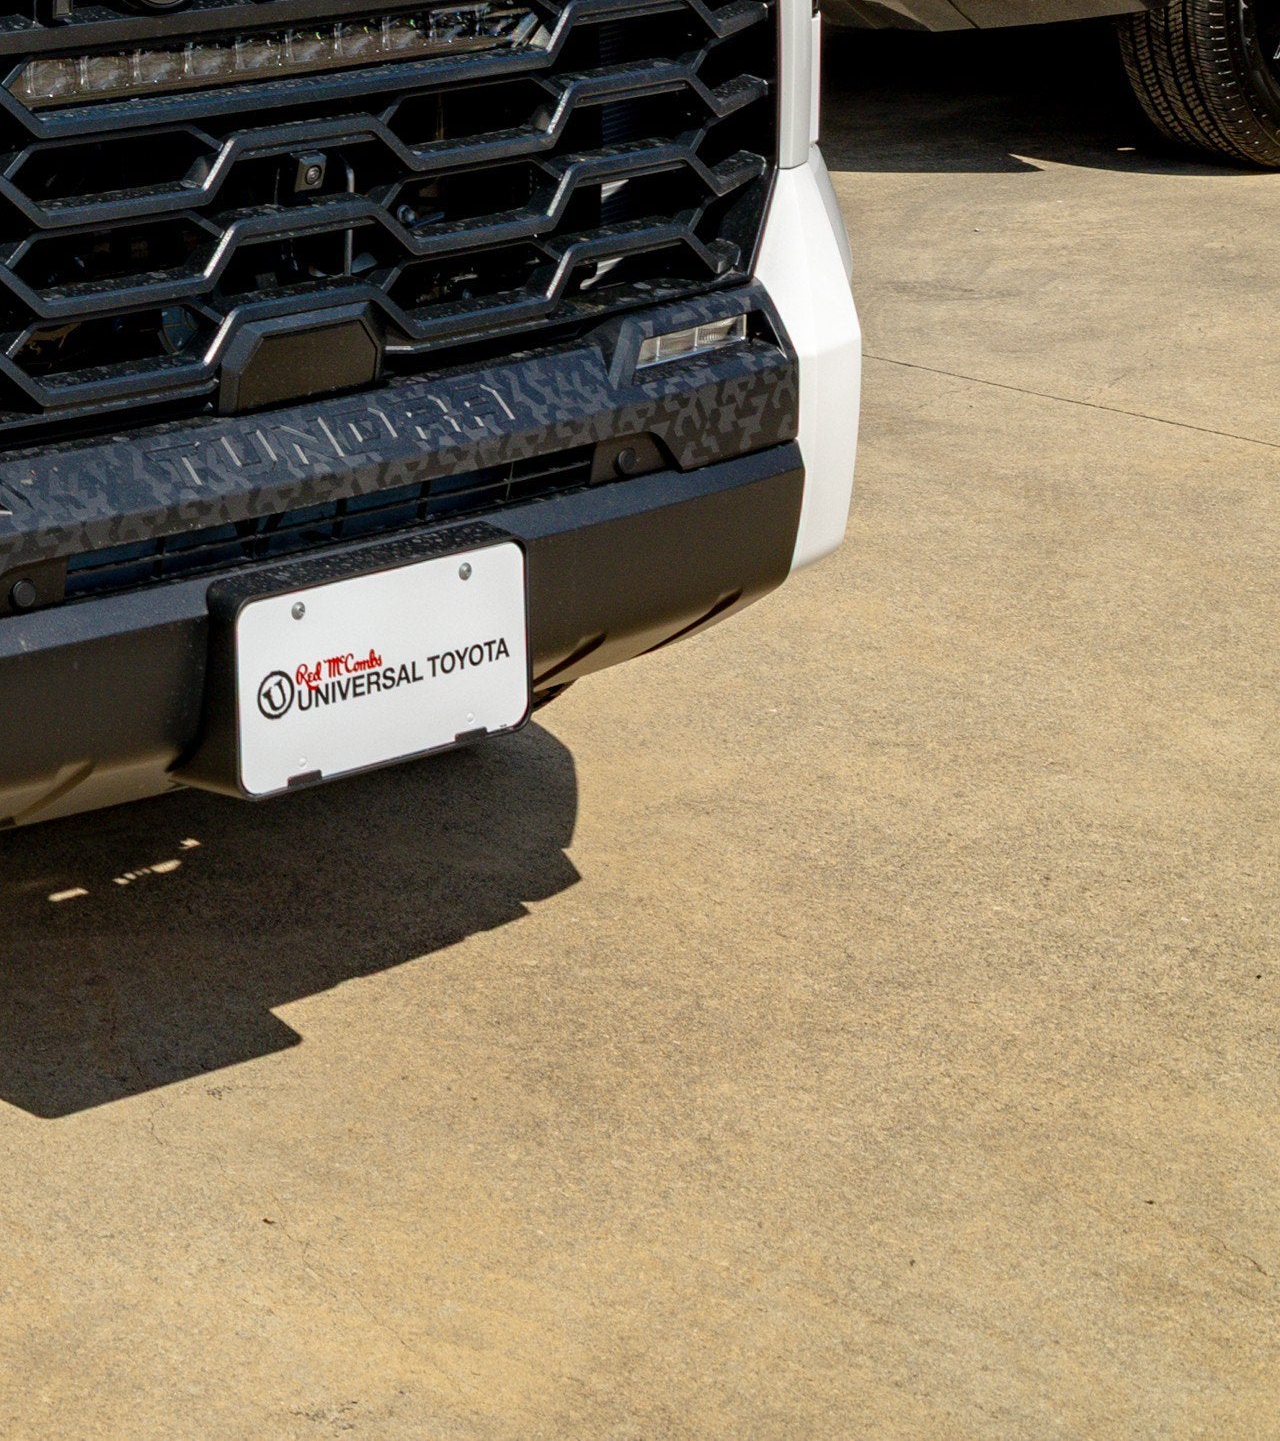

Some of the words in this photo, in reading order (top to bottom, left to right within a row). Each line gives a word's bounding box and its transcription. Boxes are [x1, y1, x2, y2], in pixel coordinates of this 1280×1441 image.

[144, 381, 518, 487] TUNDRA
[295, 662, 323, 691] Red
[297, 661, 425, 712] UNIVERSAL
[427, 637, 511, 678] TOYOTA
